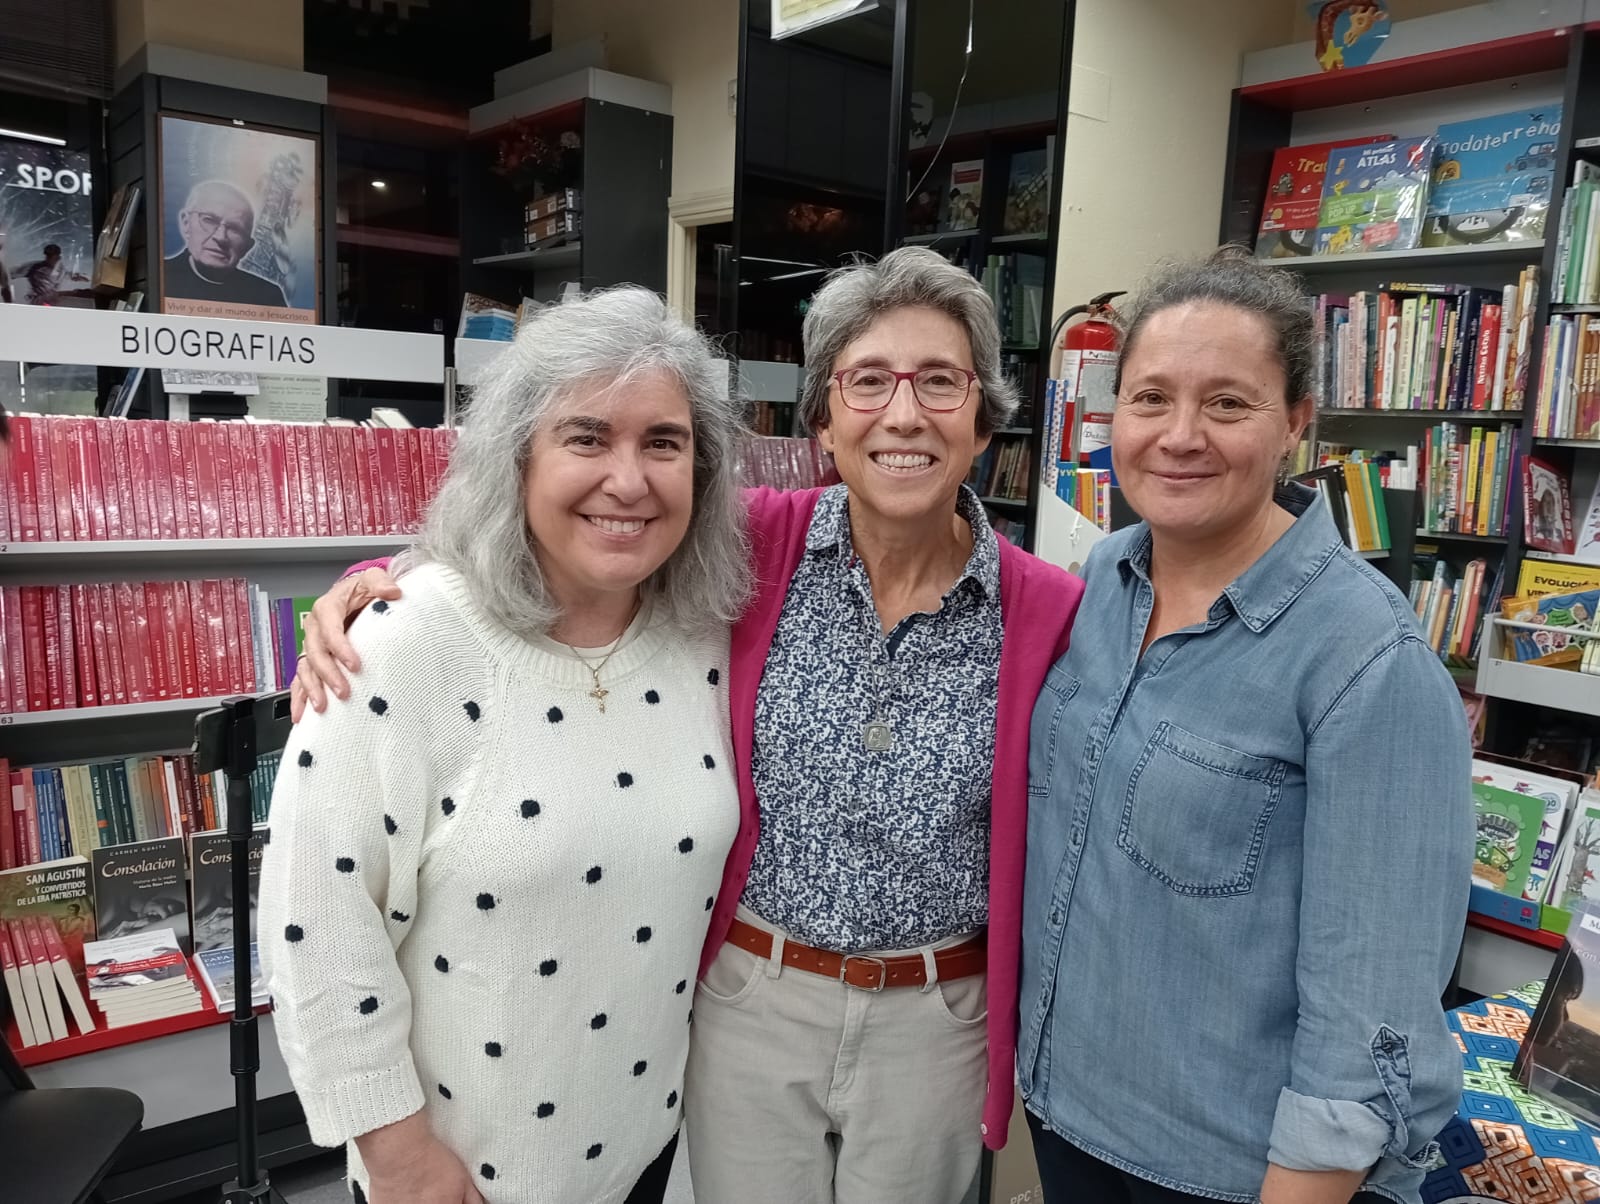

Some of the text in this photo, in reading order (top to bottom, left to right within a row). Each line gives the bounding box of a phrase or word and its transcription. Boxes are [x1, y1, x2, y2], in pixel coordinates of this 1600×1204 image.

[1357, 153, 1396, 168] ATLAS
[167, 302, 186, 311] Vivir
[189, 305, 195, 313] y
[197, 304, 213, 313] dar
[214, 306, 223, 314] al
[225, 308, 257, 317] mundo
[121, 325, 316, 364] BIOGRAFIAS
[1534, 576, 1599, 588] EVOLUC
[101, 857, 176, 878] Consolación
[25, 866, 86, 886] SAN AGUSTÍN
[35, 880, 86, 895] Y CONVERTIDOS
[17, 898, 26, 907] DE
[27, 896, 36, 905] LA
[37, 894, 50, 903] ERA
